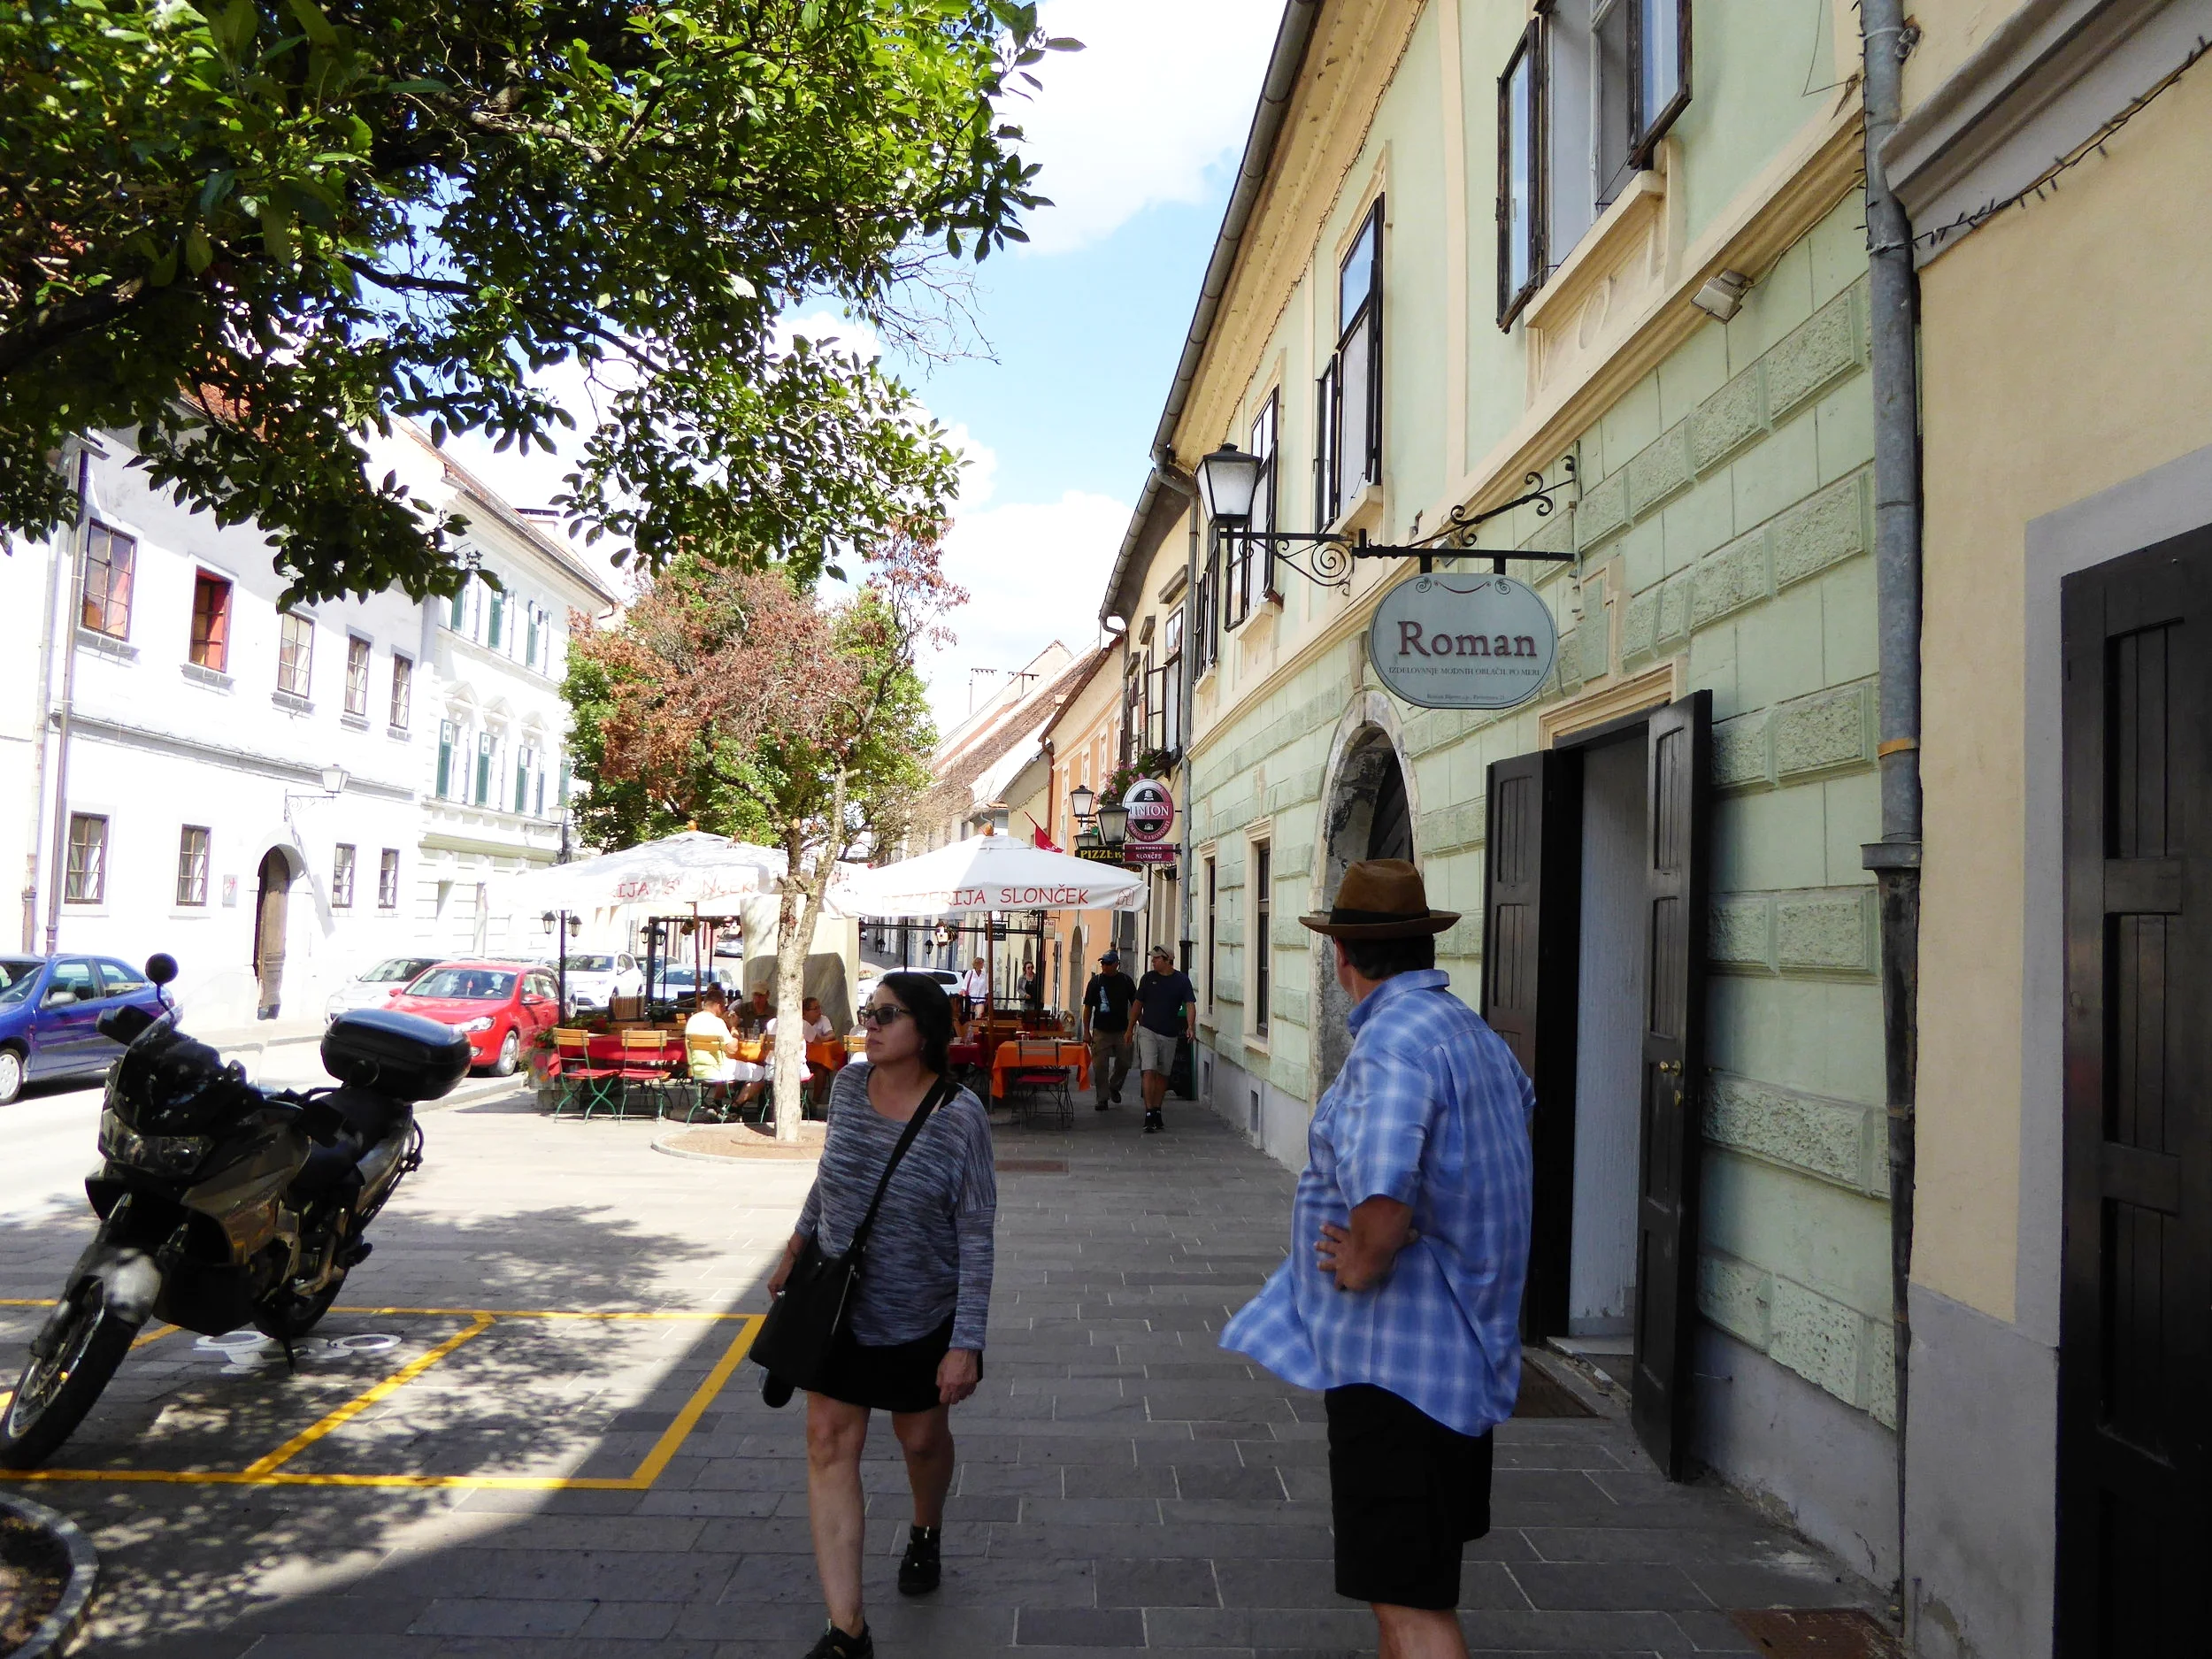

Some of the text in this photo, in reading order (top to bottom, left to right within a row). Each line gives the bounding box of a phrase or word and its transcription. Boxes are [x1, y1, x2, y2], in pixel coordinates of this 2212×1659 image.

[1397, 620, 1538, 657] Roman
[1387, 666, 1440, 676] IZDELOVANJE
[1475, 667, 1507, 676] OBLAČIL
[1130, 805, 1170, 817] UNION
[1000, 883, 1089, 904] SLONČEK
